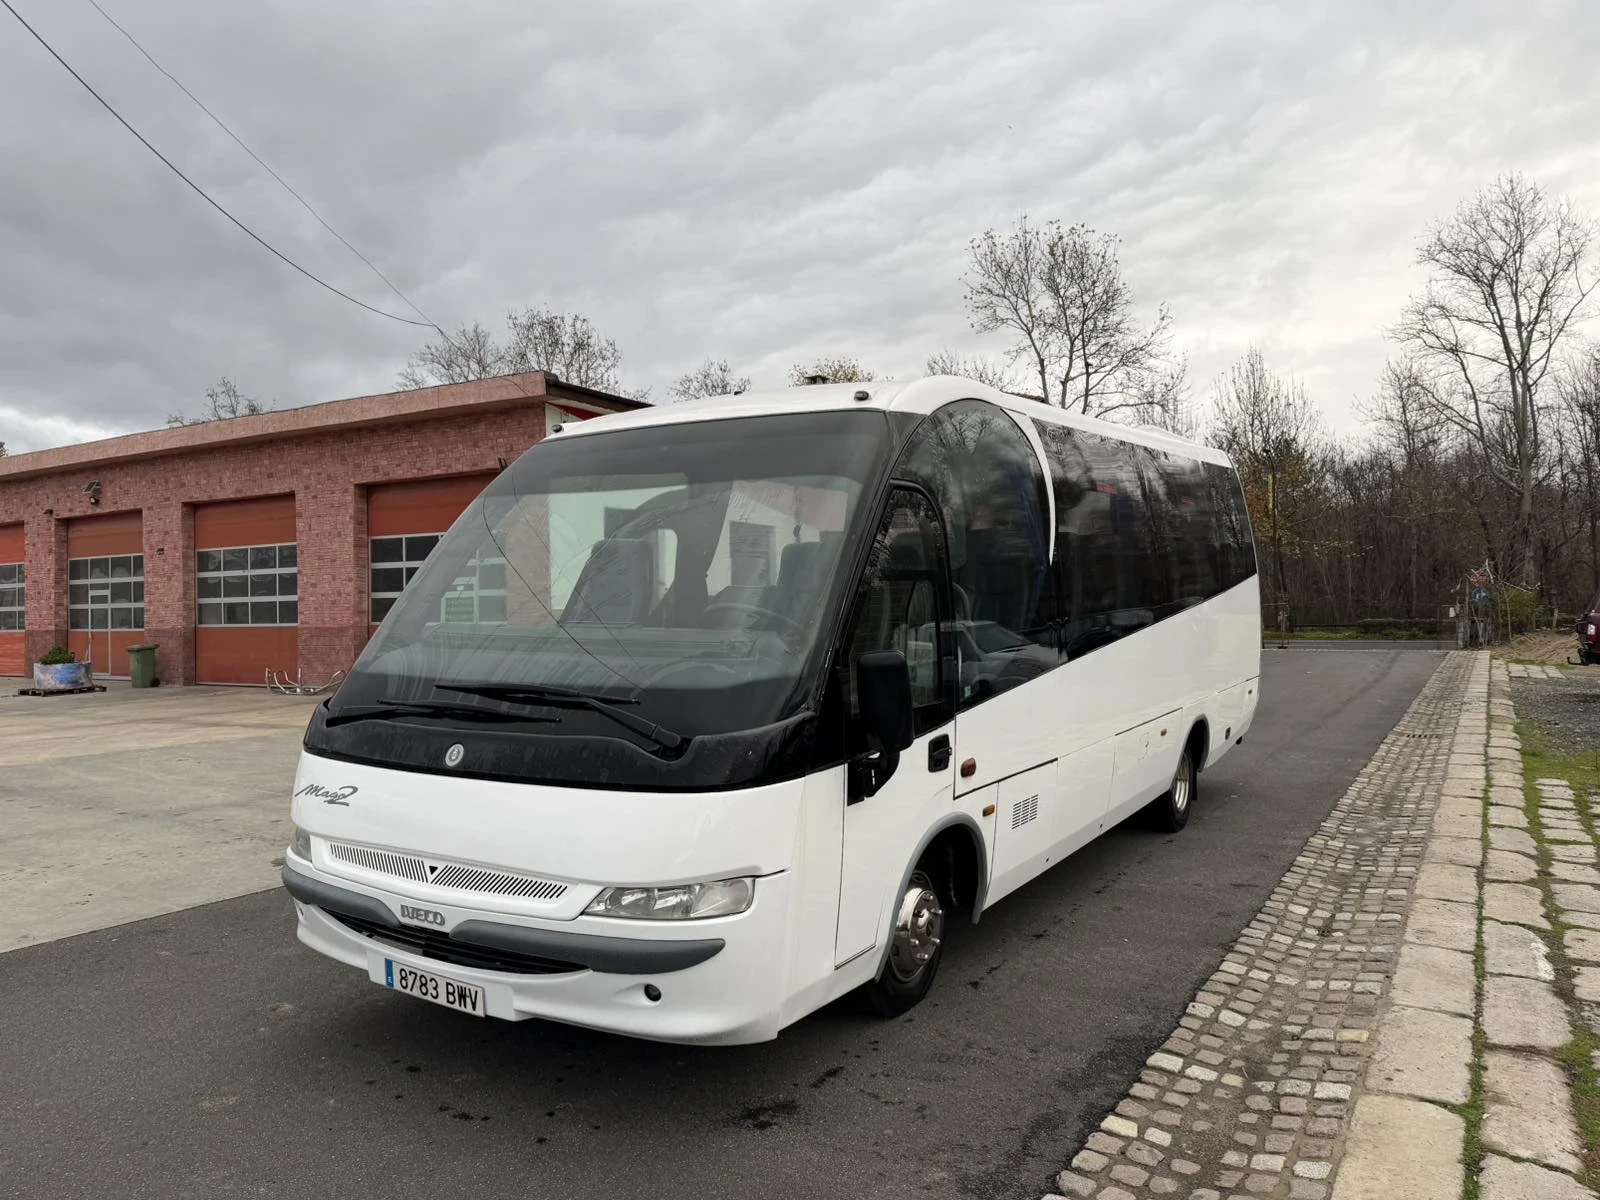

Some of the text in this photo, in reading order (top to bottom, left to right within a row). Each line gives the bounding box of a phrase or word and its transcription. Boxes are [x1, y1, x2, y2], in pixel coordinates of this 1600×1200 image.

[400, 904, 446, 926] IVECO
[399, 967, 479, 1012] 8783 BWV
